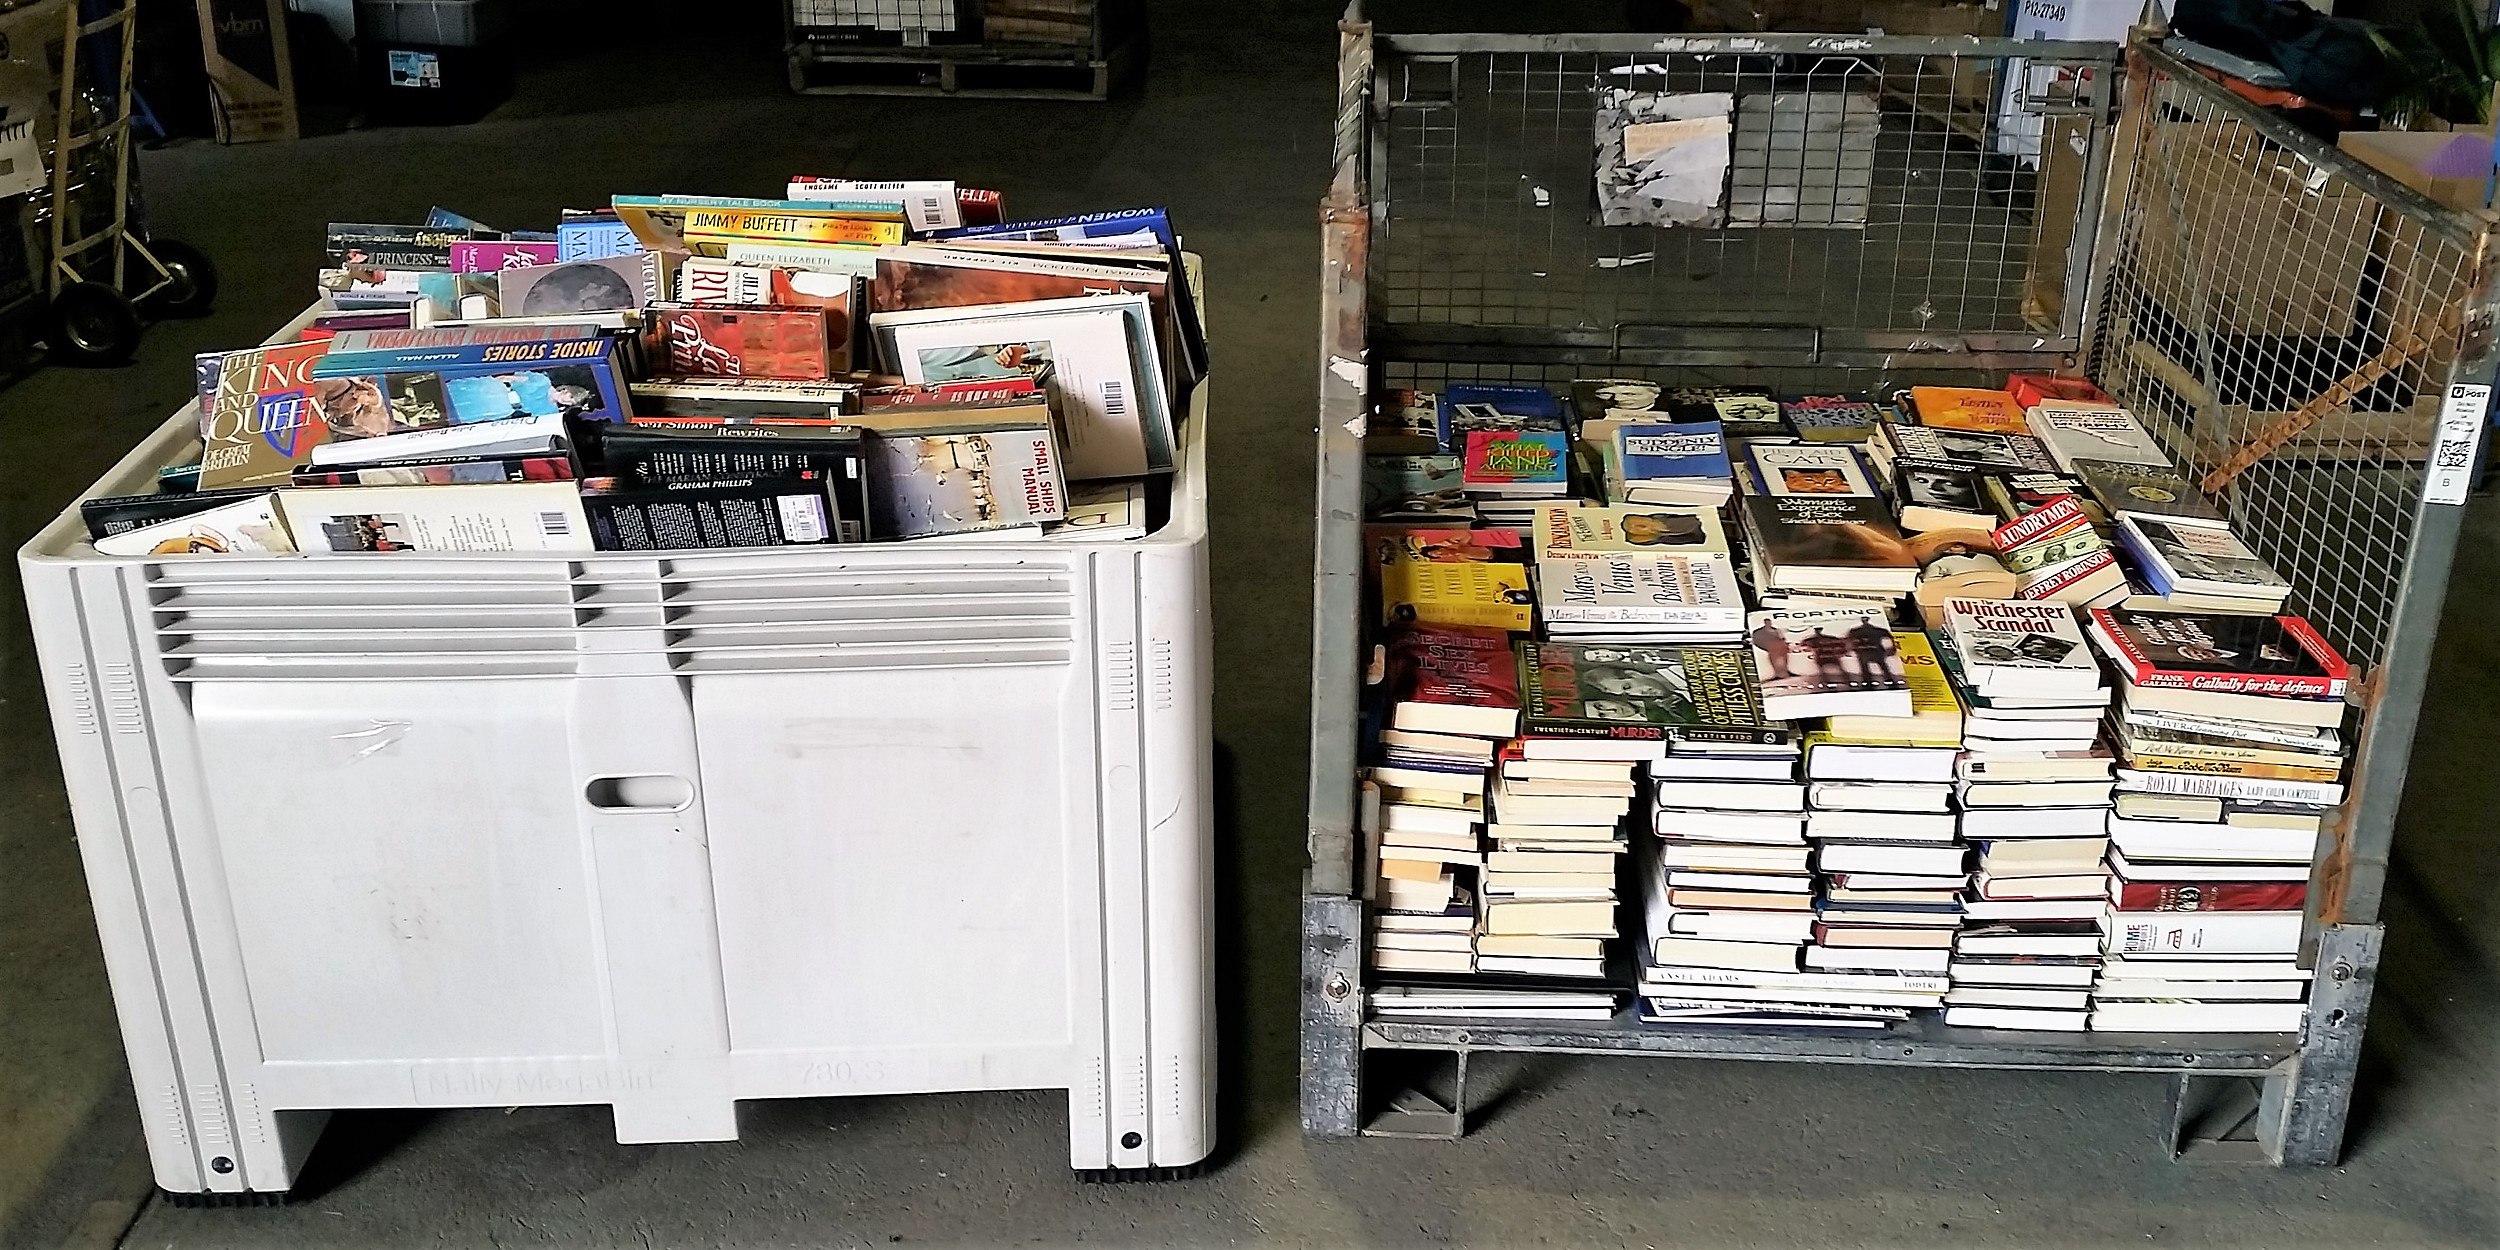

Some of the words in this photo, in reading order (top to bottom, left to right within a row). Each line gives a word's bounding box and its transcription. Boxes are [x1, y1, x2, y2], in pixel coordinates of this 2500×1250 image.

[2024, 1, 2067, 22] P12-27349
[804, 183, 839, 191] ENDGAME
[855, 183, 878, 191] SCOTT
[753, 200, 782, 208] BOOK
[1005, 216, 1063, 229] AUSTRALIA
[1078, 206, 1156, 223] WOMEN
[692, 212, 739, 233] JIMMY
[742, 216, 800, 238] BUFFETT
[375, 251, 433, 266] PRINCESS
[740, 251, 777, 265] QUEEN
[781, 253, 832, 267] ELIZABETH
[642, 252, 659, 304] VICTO
[424, 352, 461, 361] ALLAN
[482, 346, 546, 363] STORIES
[550, 340, 604, 359] INSIDE
[223, 350, 264, 372] THE
[395, 354, 423, 362] HALL
[2465, 390, 2488, 399] POST
[217, 393, 259, 413] AND
[716, 427, 781, 440] Rewrites
[1627, 436, 1718, 447] SUDDENLY
[221, 443, 253, 459] GREAT
[1638, 444, 1706, 453] SINGLE!
[202, 453, 250, 472] BRITAIN
[1031, 440, 1050, 477] SMALL
[1487, 454, 1550, 467] JANE
[1762, 453, 1849, 466] CATS
[174, 465, 202, 474] Succes
[668, 481, 711, 492] GRAHAM
[712, 477, 754, 490] PHILLIPS
[1021, 467, 1042, 517] MANUAL
[1039, 481, 1057, 515] SHIPS
[1780, 498, 1847, 506] Woman's
[1776, 503, 1858, 512] Experience
[1814, 510, 1843, 518] Sex
[1547, 507, 1573, 550] REINCARNATION
[1600, 561, 1637, 597] Venus
[1647, 561, 1683, 605] Bedroom
[2023, 571, 2065, 600] JEFFREY
[2064, 550, 2113, 580] ROBINSON
[1563, 574, 1598, 605] Mars
[1772, 608, 1883, 621] RORTING
[1951, 600, 2065, 620] Winchester
[1973, 616, 2057, 634] Scandal
[1409, 632, 1497, 650] SECRET
[1428, 645, 1476, 662] SEX
[1695, 650, 1714, 671] MOST
[1418, 657, 1490, 675] LIVES
[1710, 650, 1743, 686] CRIMES
[2140, 680, 2191, 688] GALBALLY
[2150, 673, 2184, 682] FRANK
[2192, 676, 2243, 692] Galbally
[2242, 678, 2263, 693] for
[2263, 680, 2282, 691] the
[2282, 682, 2325, 695] defence
[1708, 699, 1727, 713] THE
[1722, 687, 1756, 726] PITILESS
[1711, 712, 1730, 725] OF
[1533, 725, 1609, 736] TWENTIETH-CENTURY
[1610, 726, 1662, 740] MURDER
[1688, 731, 1727, 740] MARTIN
[1729, 733, 1753, 741] FIDO
[2232, 729, 2248, 738] Diet
[2146, 775, 2177, 792] ROYAL
[2182, 778, 2243, 796] MARRIAGES
[2246, 784, 2264, 797] LADY
[2265, 786, 2285, 797] COLIN
[2286, 788, 2321, 800] CAMPBELL
[2123, 924, 2141, 952] HOME
[1701, 974, 1740, 984] ADAMS
[429, 1070, 502, 1096] Nally
